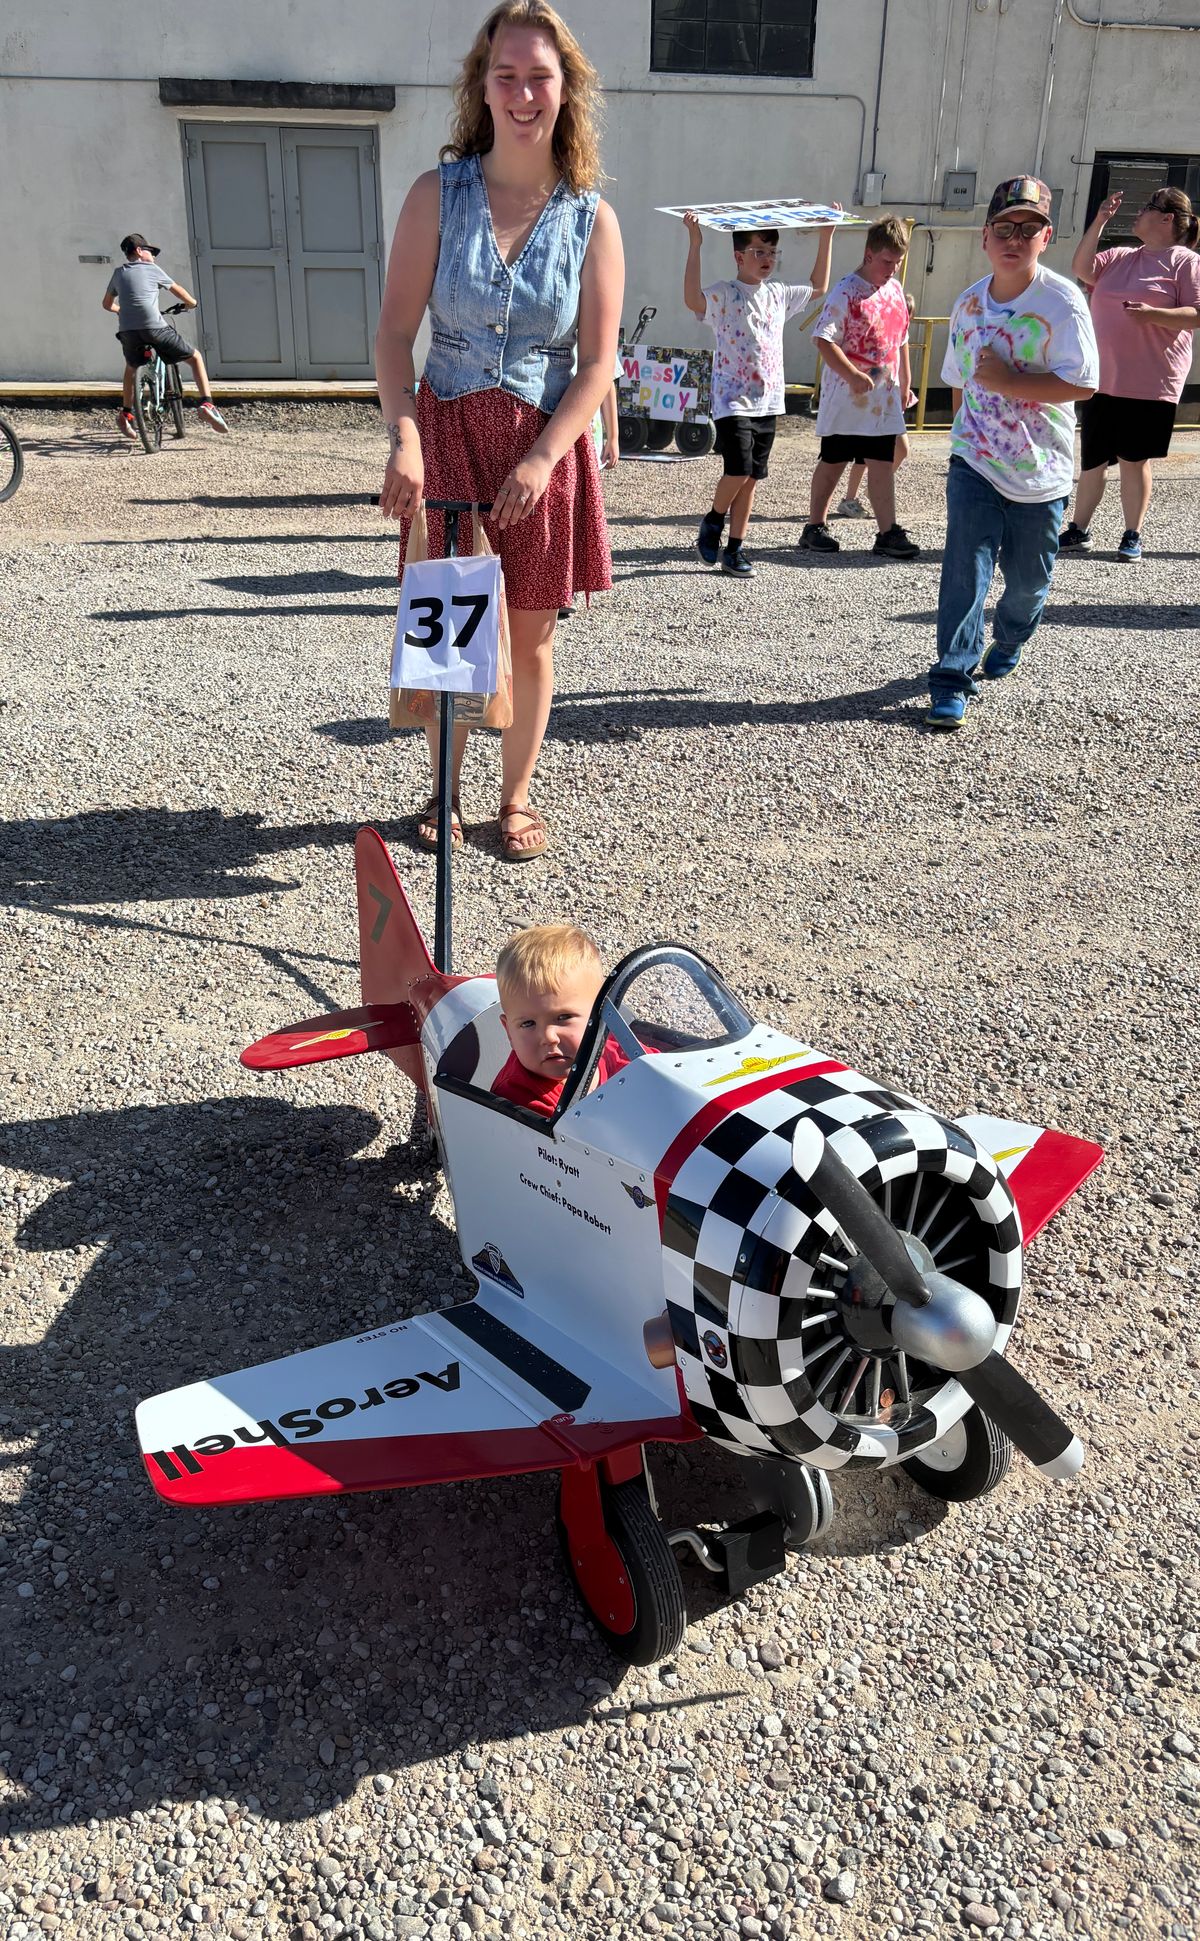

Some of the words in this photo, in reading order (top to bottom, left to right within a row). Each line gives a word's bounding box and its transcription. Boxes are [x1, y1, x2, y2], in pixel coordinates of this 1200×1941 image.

[623, 358, 685, 385] Messy
[639, 387, 691, 412] Play
[404, 594, 489, 649] 37
[537, 1146, 558, 1166] Pilot:
[558, 1157, 580, 1179] Ryatt
[519, 1172, 539, 1191] Crew
[539, 1184, 562, 1205] Chief:
[562, 1197, 583, 1217] Papa
[583, 1209, 612, 1236] Robert
[356, 1331, 387, 1344] STEP
[389, 1325, 409, 1334] NO
[150, 1361, 461, 1482] AeroShell
